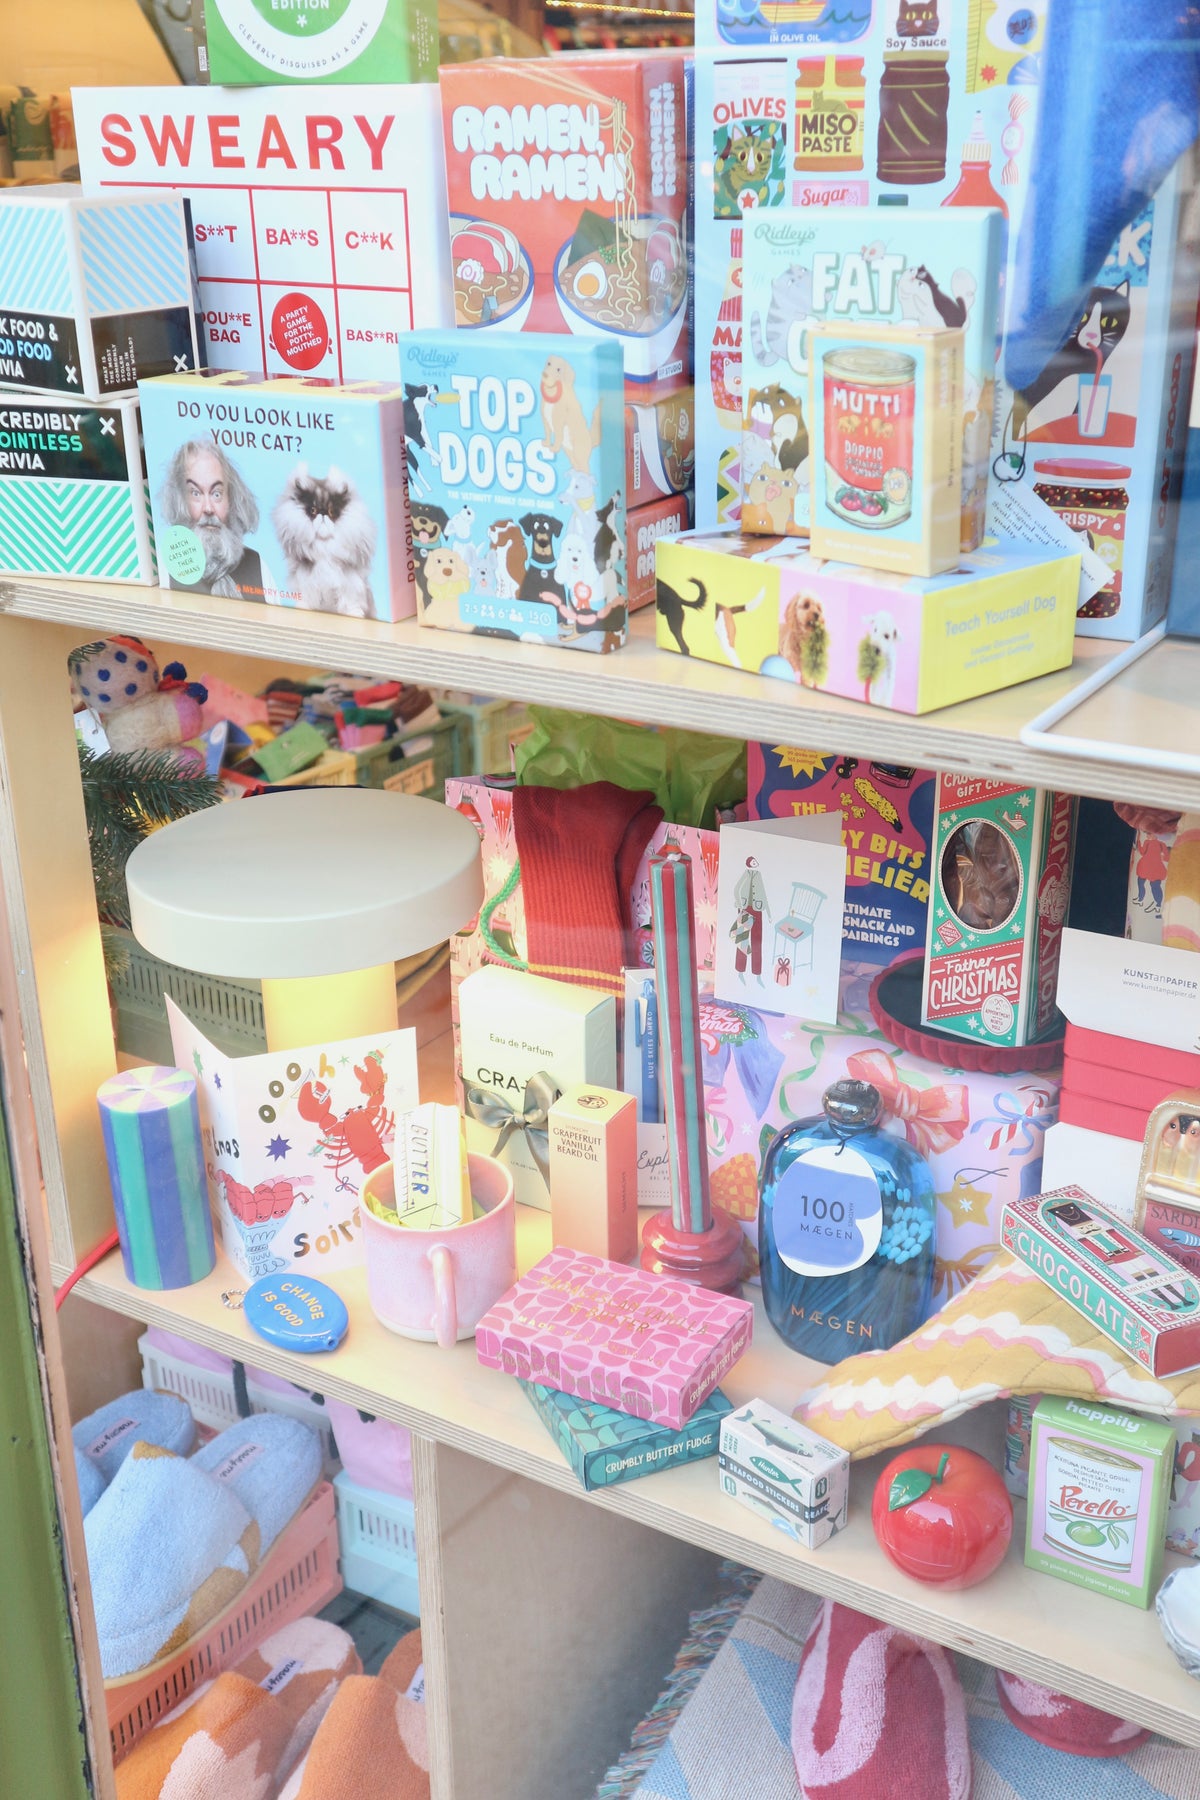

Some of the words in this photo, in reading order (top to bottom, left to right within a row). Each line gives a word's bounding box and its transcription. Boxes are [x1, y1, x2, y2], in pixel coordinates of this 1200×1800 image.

[271, 0, 329, 10] EDITION
[237, 23, 276, 60] CLEVERLY
[280, 58, 327, 69] DISGUISED
[331, 53, 342, 63] AS
[343, 46, 350, 54] A
[350, 21, 369, 46] GAME
[769, 33, 778, 42] IN
[780, 33, 805, 43] OLIVE
[806, 34, 821, 42] OIL
[886, 38, 906, 52] Soy
[911, 37, 947, 48] Sauce
[713, 97, 786, 124] OLIVES
[452, 104, 605, 156] RAMEN,
[801, 113, 856, 135] MISO
[101, 114, 396, 170] SWEARY
[802, 136, 852, 154] PASTE
[801, 188, 848, 207] Sugar
[811, 252, 906, 314] FAT
[286, 305, 309, 321] PARTY
[286, 315, 307, 330] GAME
[11, 318, 45, 340] FOOD
[49, 323, 58, 341] &
[209, 328, 241, 344] BAG
[284, 329, 298, 340] FOR
[299, 322, 313, 335] THE
[289, 332, 314, 346] POTTY-
[17, 340, 52, 360] FOOD
[286, 337, 322, 356] MOUTHED
[112, 343, 120, 383] COMMONLY
[451, 374, 536, 433] TOP
[833, 386, 900, 416] MUTTI
[177, 401, 201, 418] DO
[205, 403, 239, 422] YOU
[244, 407, 292, 427] LOOK
[296, 411, 335, 431] LIKE
[210, 428, 257, 449] YOUR
[261, 433, 302, 453] CAT?
[844, 439, 884, 460] DOPPIO
[438, 431, 557, 496] DOGS
[1060, 511, 1107, 529] RISPY
[168, 553, 183, 562] CATS
[182, 547, 197, 557] WITH
[170, 540, 189, 551] MATCH
[177, 557, 194, 568] THEIR
[243, 585, 277, 597] MEMORY
[280, 591, 303, 600] GAME
[945, 615, 981, 637] Teach
[1034, 595, 1056, 613] Dog
[957, 782, 982, 798] GIFT
[791, 801, 826, 816] THE
[870, 833, 926, 869] BITS
[842, 902, 891, 920] LTIMATE
[844, 916, 885, 932] SNACK
[887, 923, 915, 936] AND
[842, 929, 900, 947] PAIRINGS
[945, 956, 994, 975] Father
[1040, 927, 1060, 1023] HOLLY
[930, 963, 1018, 1010] CHRISTMAS
[1122, 979, 1197, 1000] www.kunstanpapier.de
[1123, 968, 1198, 990] KUNSTanPAPIER
[489, 1033, 505, 1045] Eau
[508, 1039, 519, 1048] de
[521, 1042, 554, 1057] Parfum
[553, 1127, 602, 1146] GRAPEFRUIT
[561, 1138, 593, 1152] VANILLA
[411, 1124, 430, 1195] BUTTER
[557, 1145, 583, 1158] BEARD
[584, 1152, 598, 1162] OIL
[801, 1195, 845, 1223] 100
[800, 1223, 853, 1240] MÆGEN
[1017, 1231, 1133, 1345] CHOCOLATE
[261, 1291, 277, 1302] IS
[274, 1303, 303, 1327] GOOD
[280, 1283, 325, 1320] CHANGE
[586, 1307, 650, 1335] BUTTER
[790, 1304, 873, 1338] MÆGEN
[690, 1375, 711, 1404] CRUMBLY
[711, 1352, 731, 1380] BUTTERY
[731, 1336, 745, 1355] FUDGE
[1065, 1400, 1140, 1433] happily
[605, 1455, 644, 1474] CRUMBLY
[646, 1443, 683, 1463] BUTTERY
[686, 1434, 712, 1451] FUDGE
[757, 1460, 780, 1479] Hunter
[729, 1462, 764, 1489] SEAFOOD
[765, 1484, 800, 1513] STICKERS
